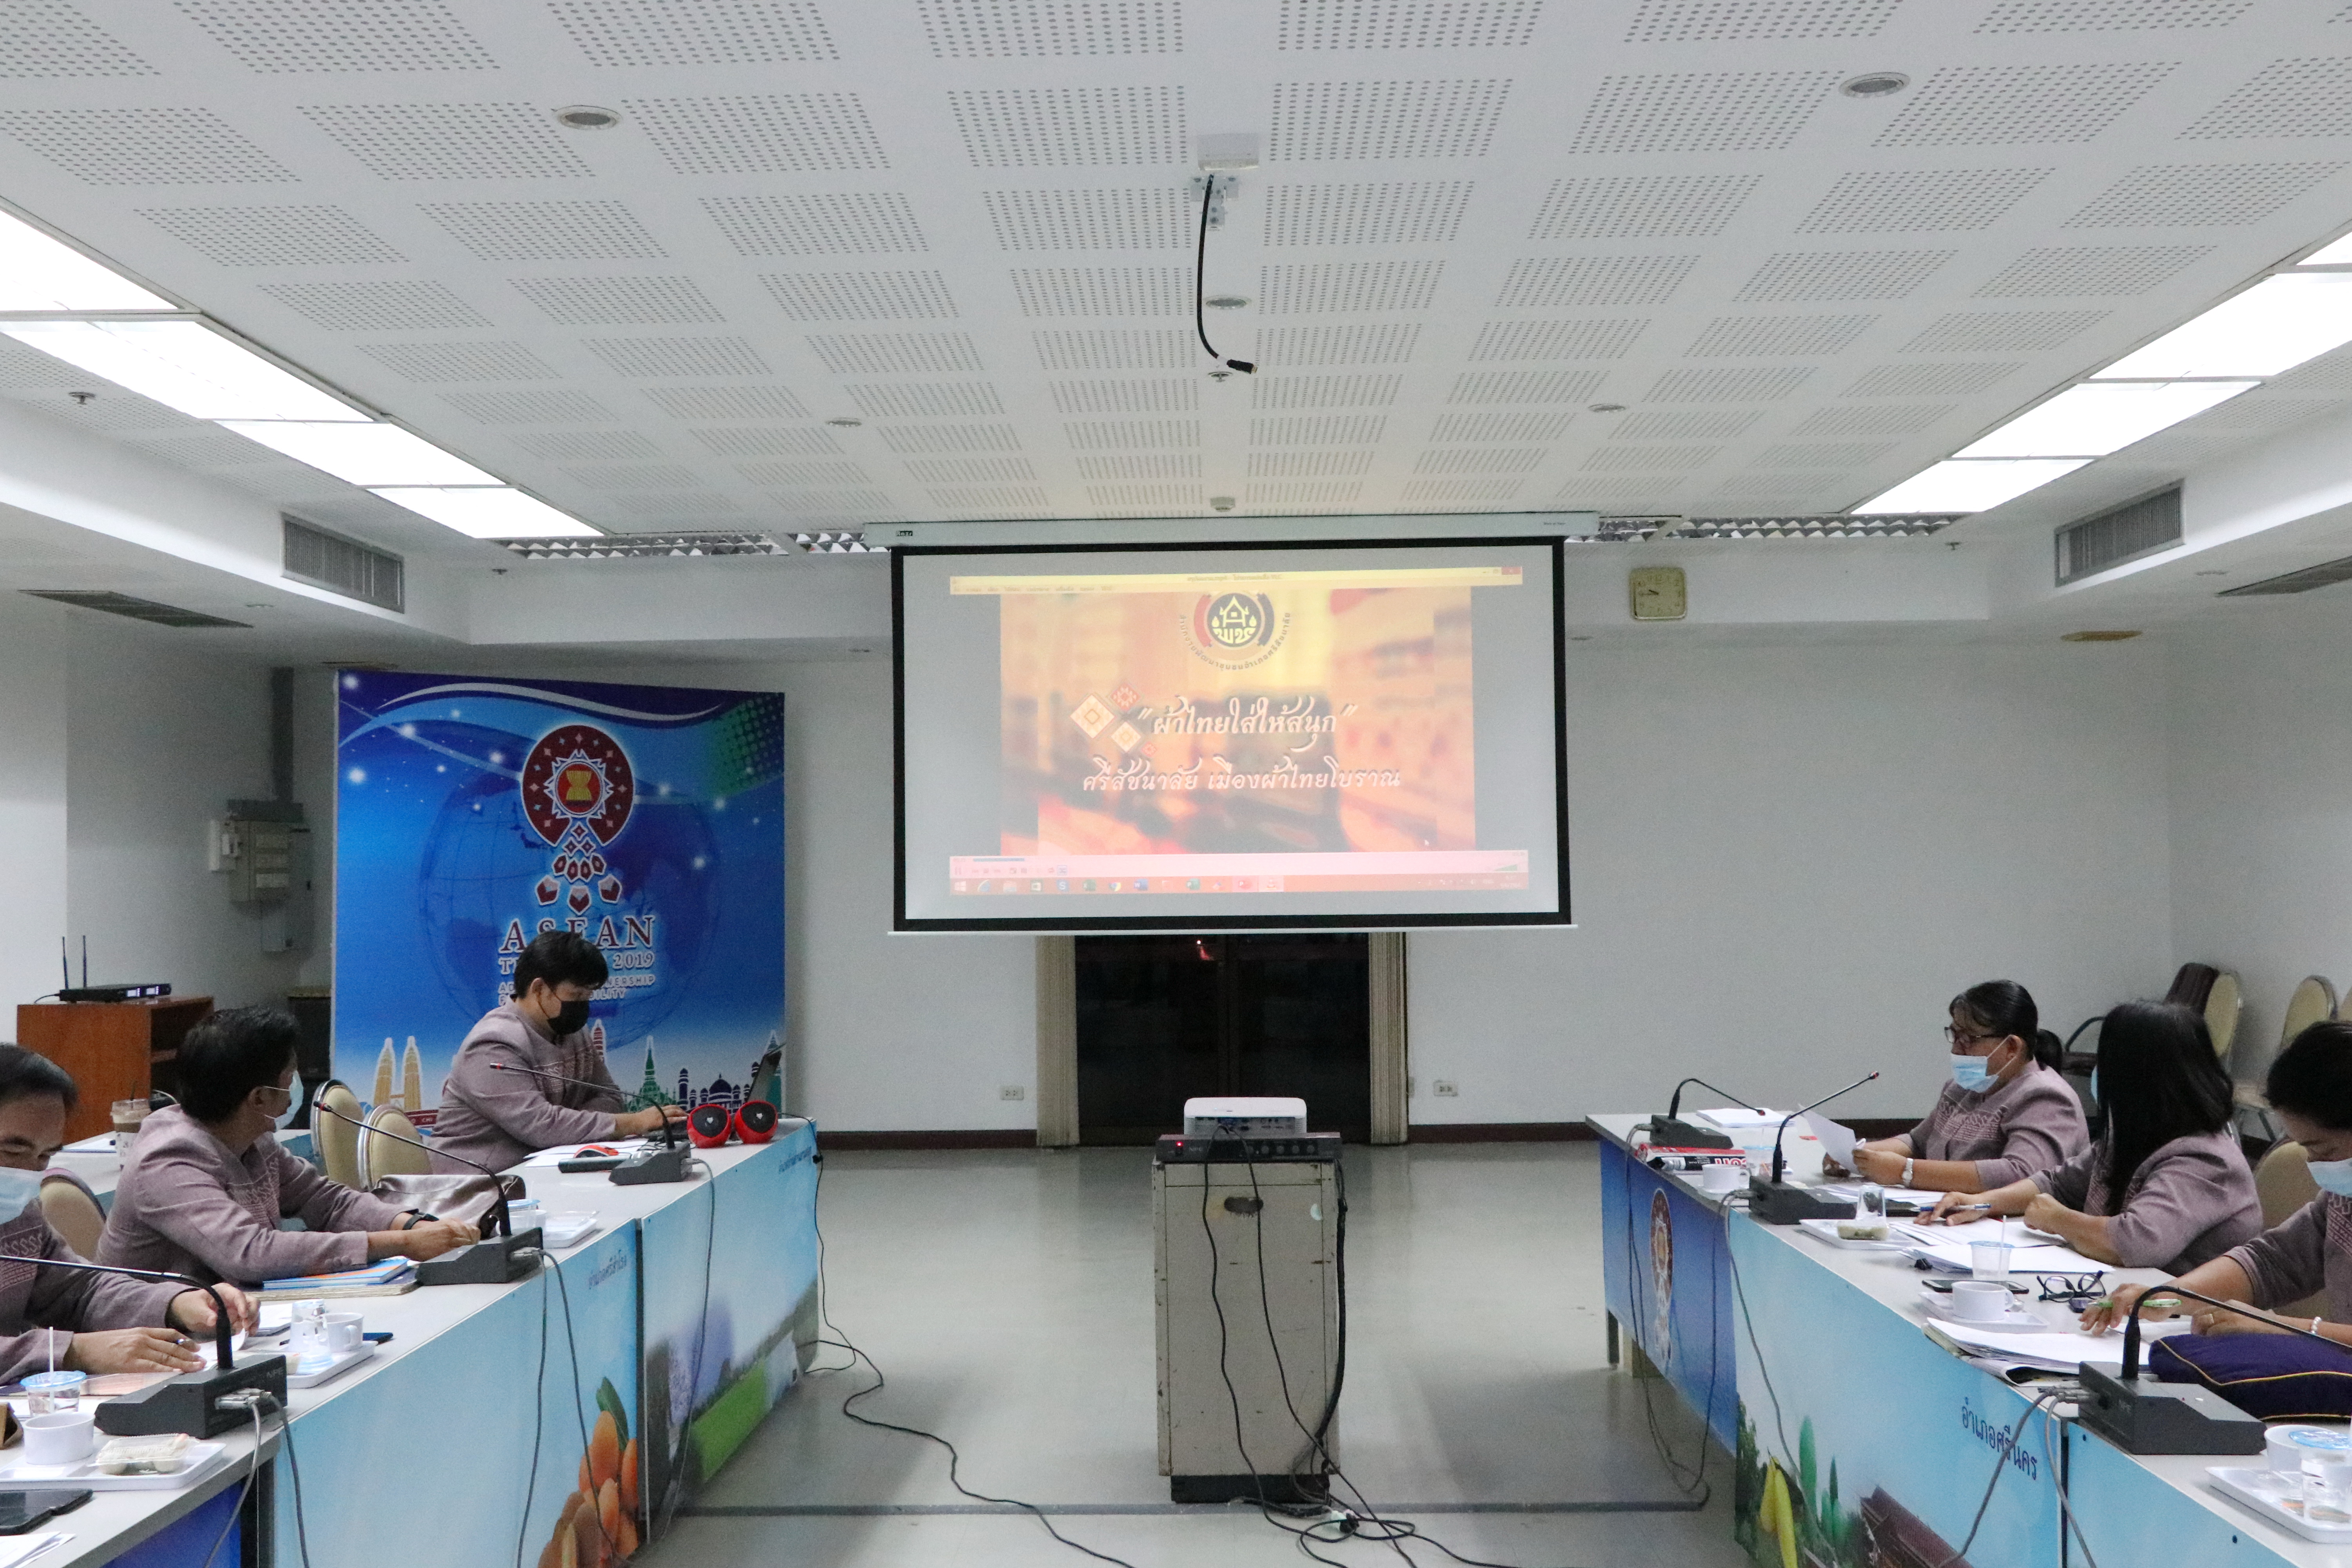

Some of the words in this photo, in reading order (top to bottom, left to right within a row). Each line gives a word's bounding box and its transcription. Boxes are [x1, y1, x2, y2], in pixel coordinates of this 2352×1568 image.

[1083, 757, 1202, 791] ศรีสัชนาลัย
[1208, 755, 1401, 790] เมืองผ้าไทยโบราณ
[613, 953, 653, 968] 2019
